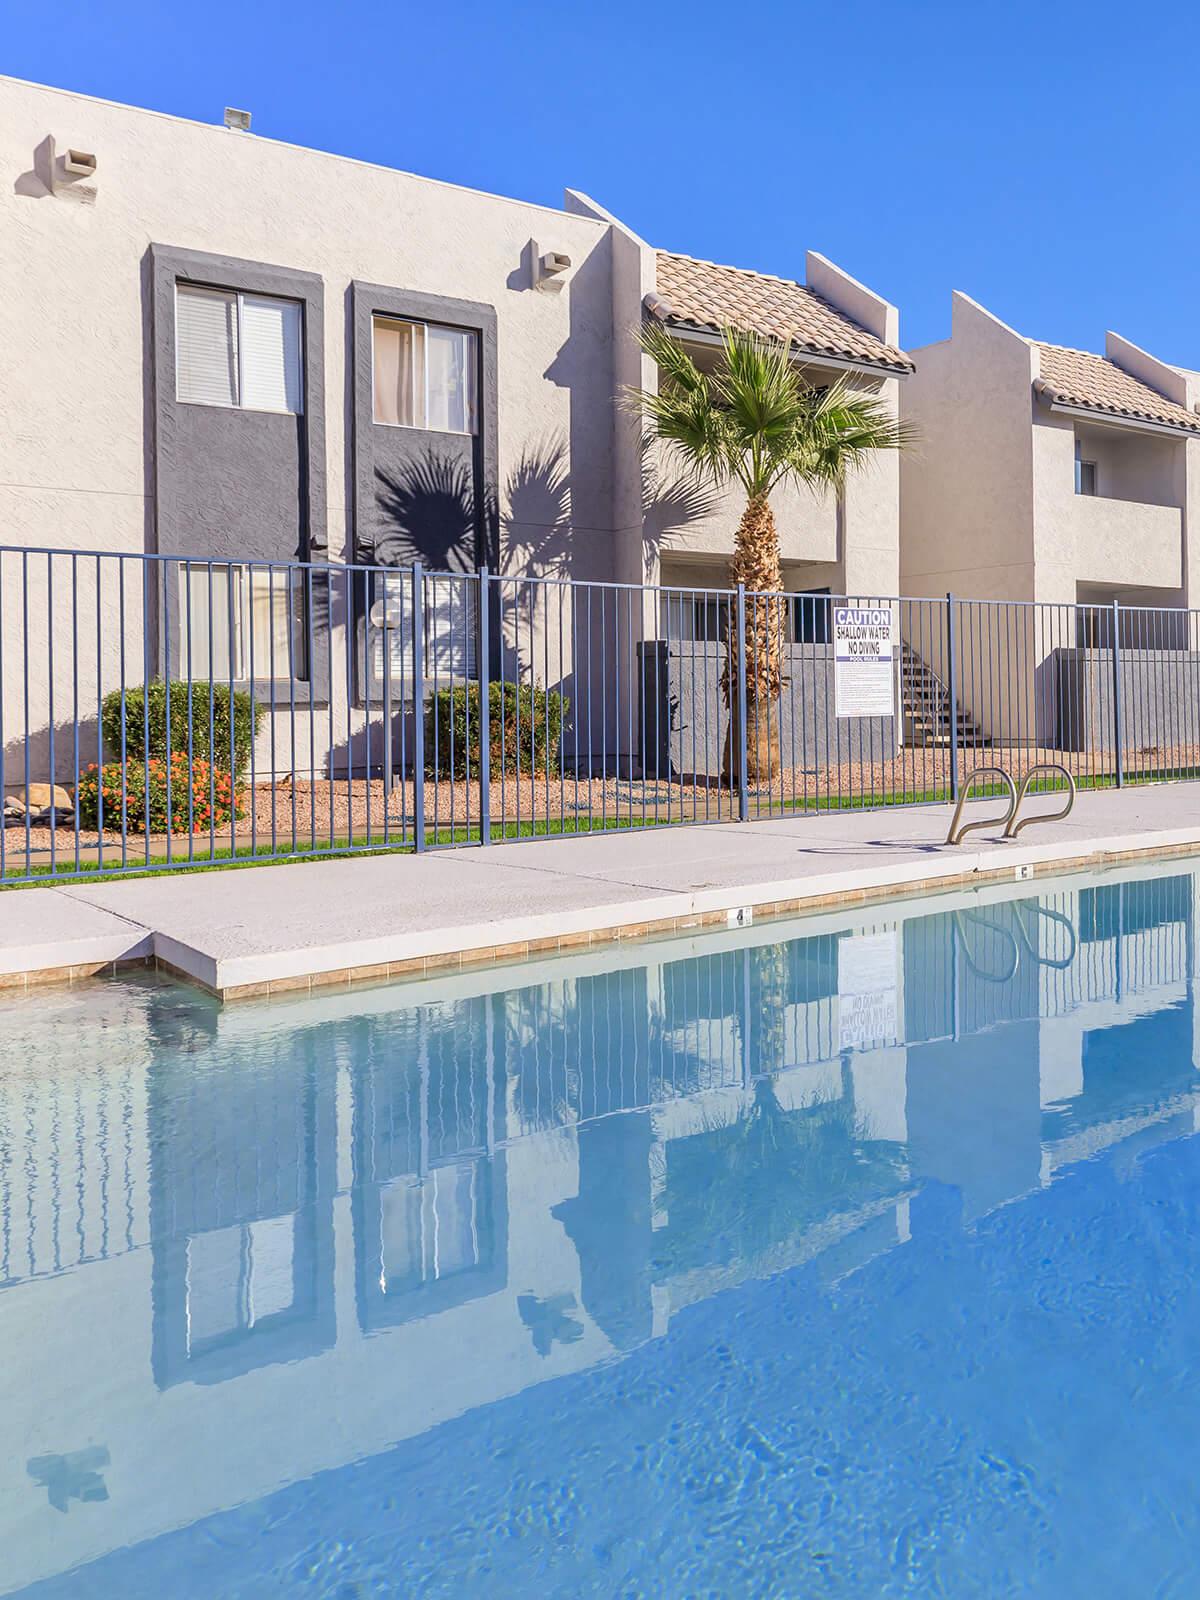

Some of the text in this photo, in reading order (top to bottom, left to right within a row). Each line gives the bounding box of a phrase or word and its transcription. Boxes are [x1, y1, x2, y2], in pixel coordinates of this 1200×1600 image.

[837, 610, 889, 624] CAUTION
[837, 626, 889, 639] SHALLOW WATER
[848, 641, 879, 654] NO DIVING
